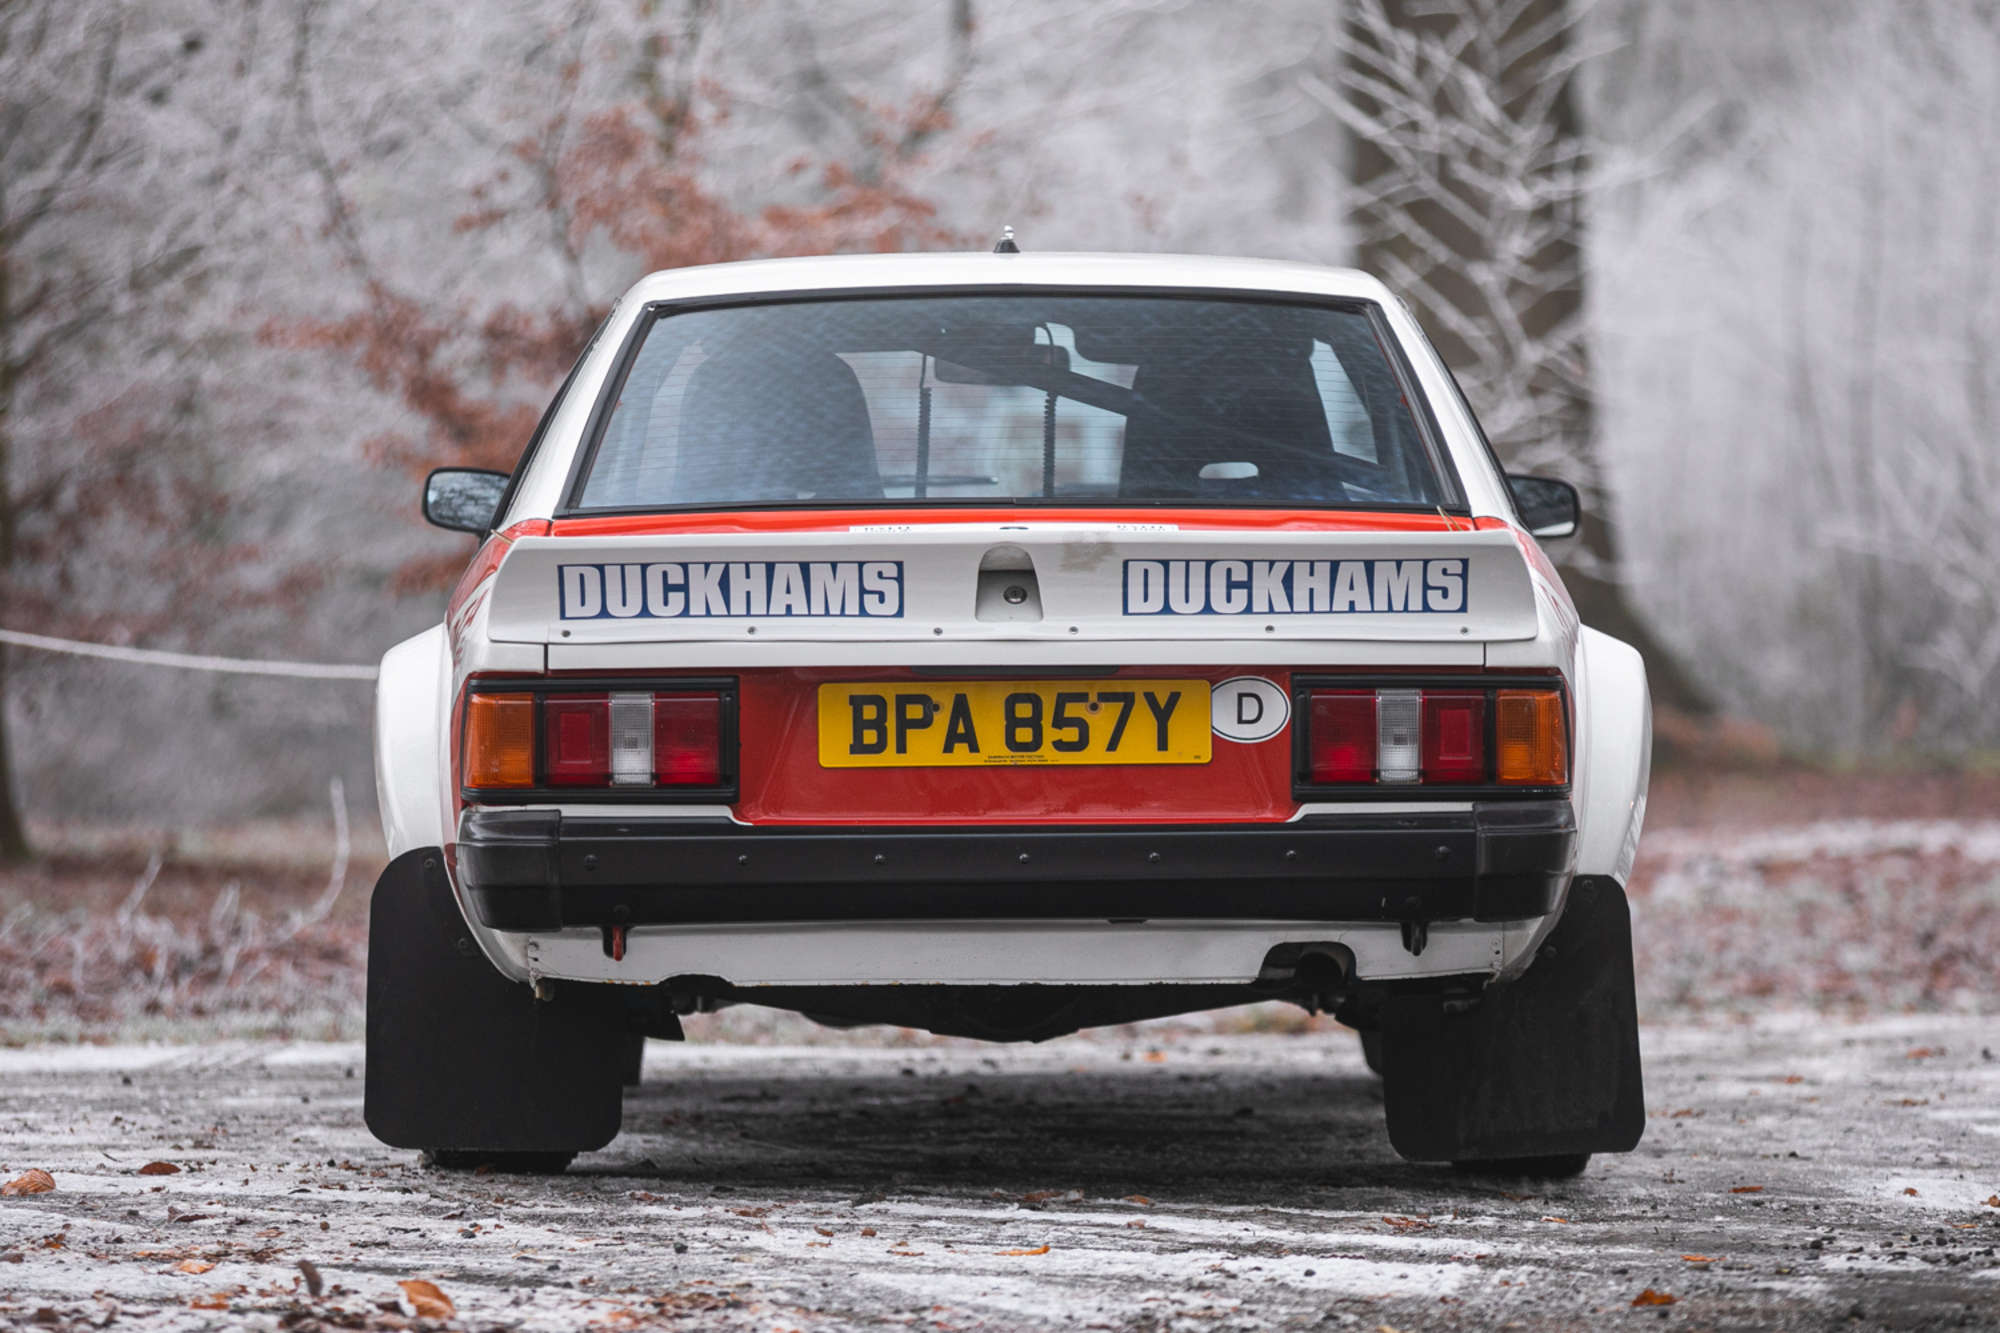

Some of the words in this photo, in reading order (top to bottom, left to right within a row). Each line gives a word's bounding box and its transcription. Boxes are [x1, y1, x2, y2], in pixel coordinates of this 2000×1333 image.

[562, 561, 901, 618] DUCKHAMS
[1127, 558, 1465, 615] DUCKHAMS
[848, 693, 981, 755] BPA
[1003, 690, 1183, 754] 857Y
[1236, 692, 1265, 726] D
